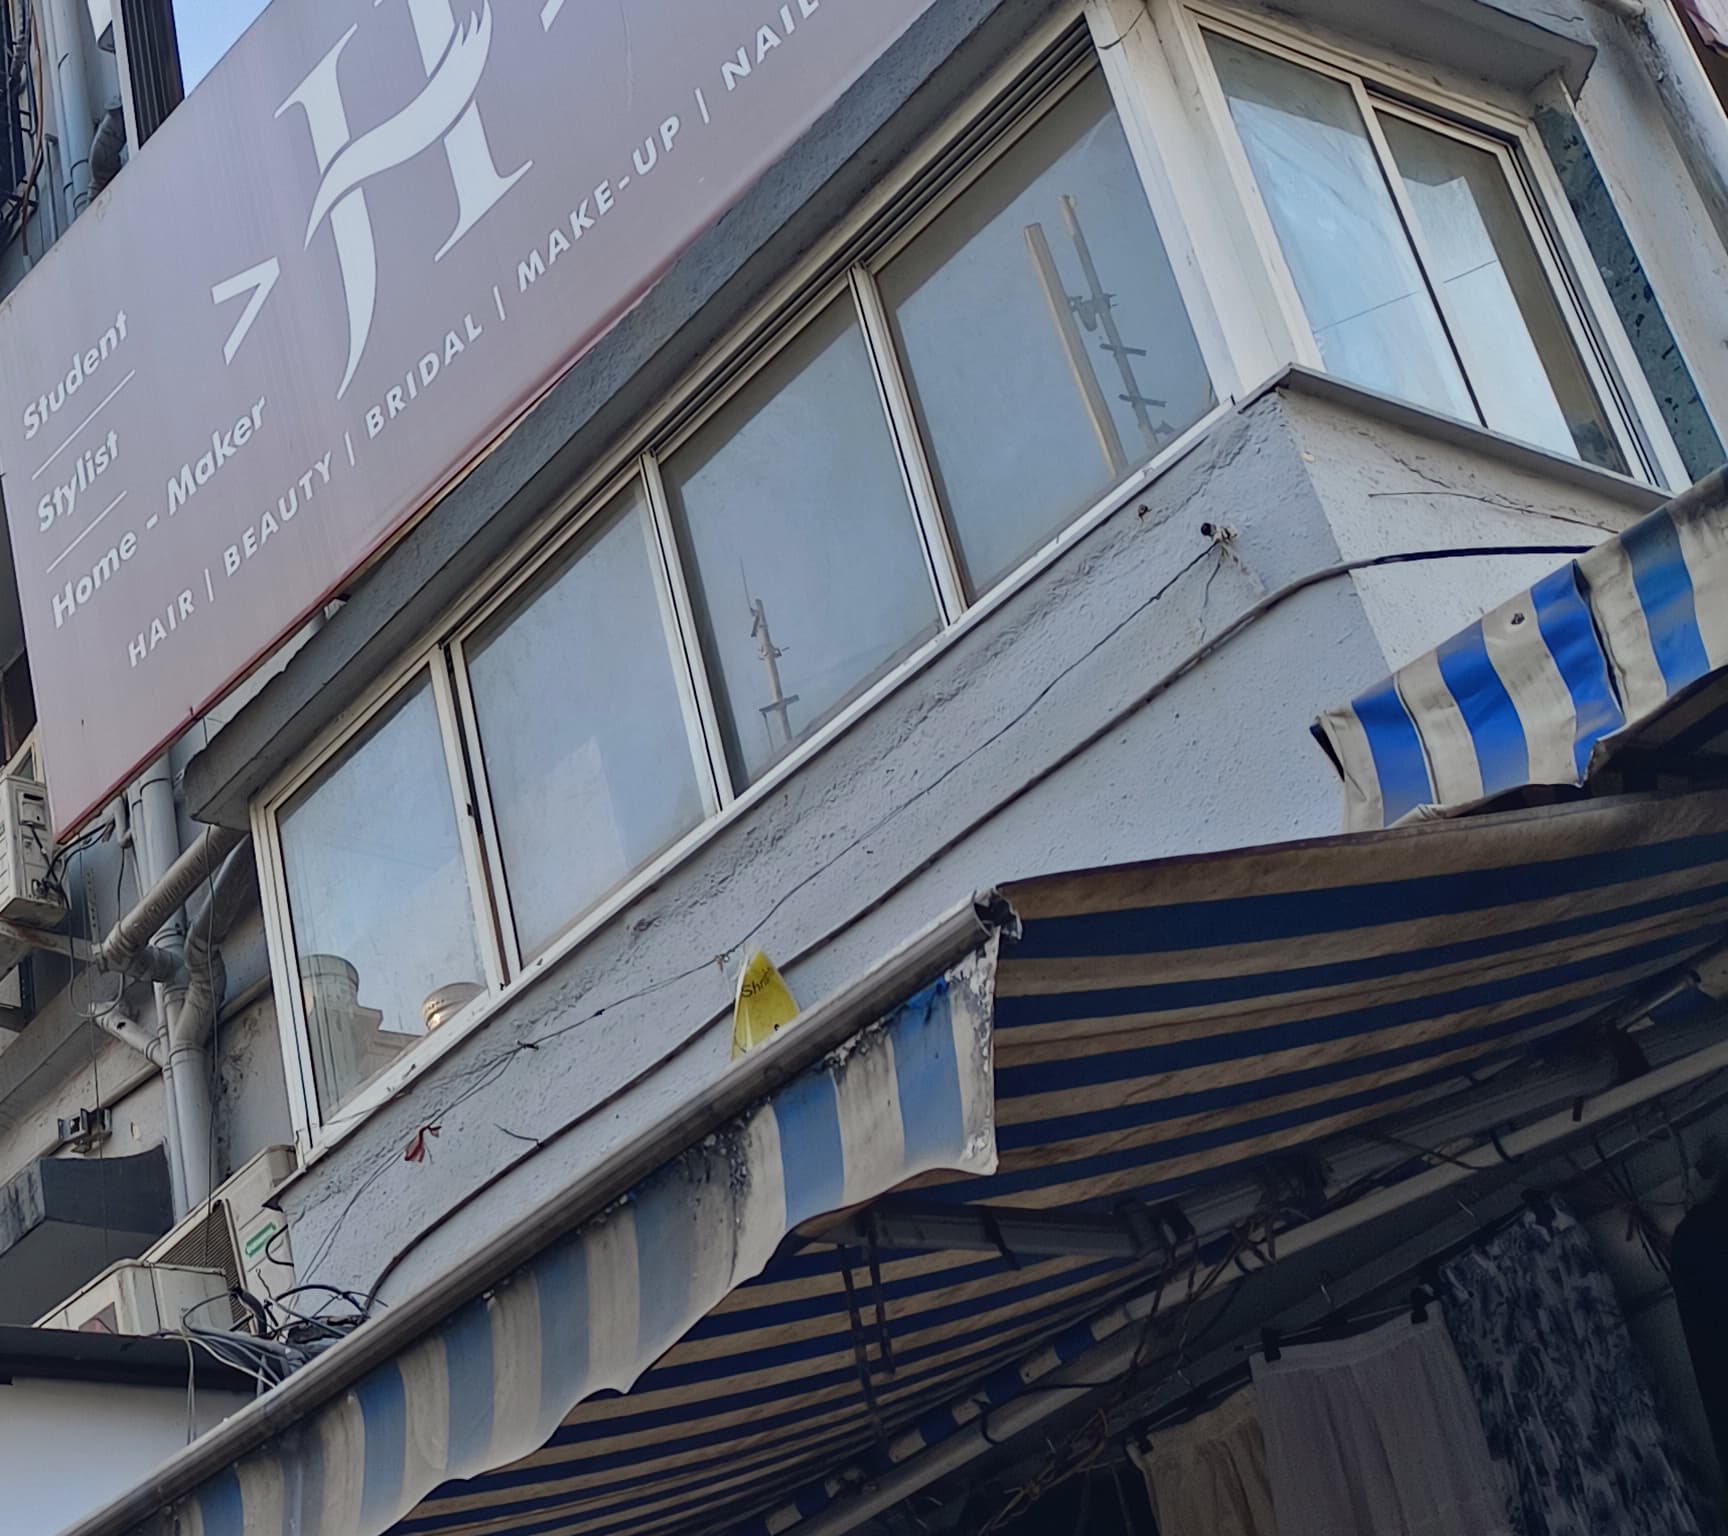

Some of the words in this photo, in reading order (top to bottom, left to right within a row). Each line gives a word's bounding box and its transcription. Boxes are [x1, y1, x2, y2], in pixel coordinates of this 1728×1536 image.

[23, 309, 128, 440] Student
[127, 588, 195, 667] HAIR
[223, 450, 332, 577] BEAUTY
[365, 312, 484, 440] BRIDAL
[518, 115, 683, 293] MAKE-UP
[37, 429, 119, 532] Stylist
[51, 531, 137, 629] Home
[167, 395, 266, 515] Maker
